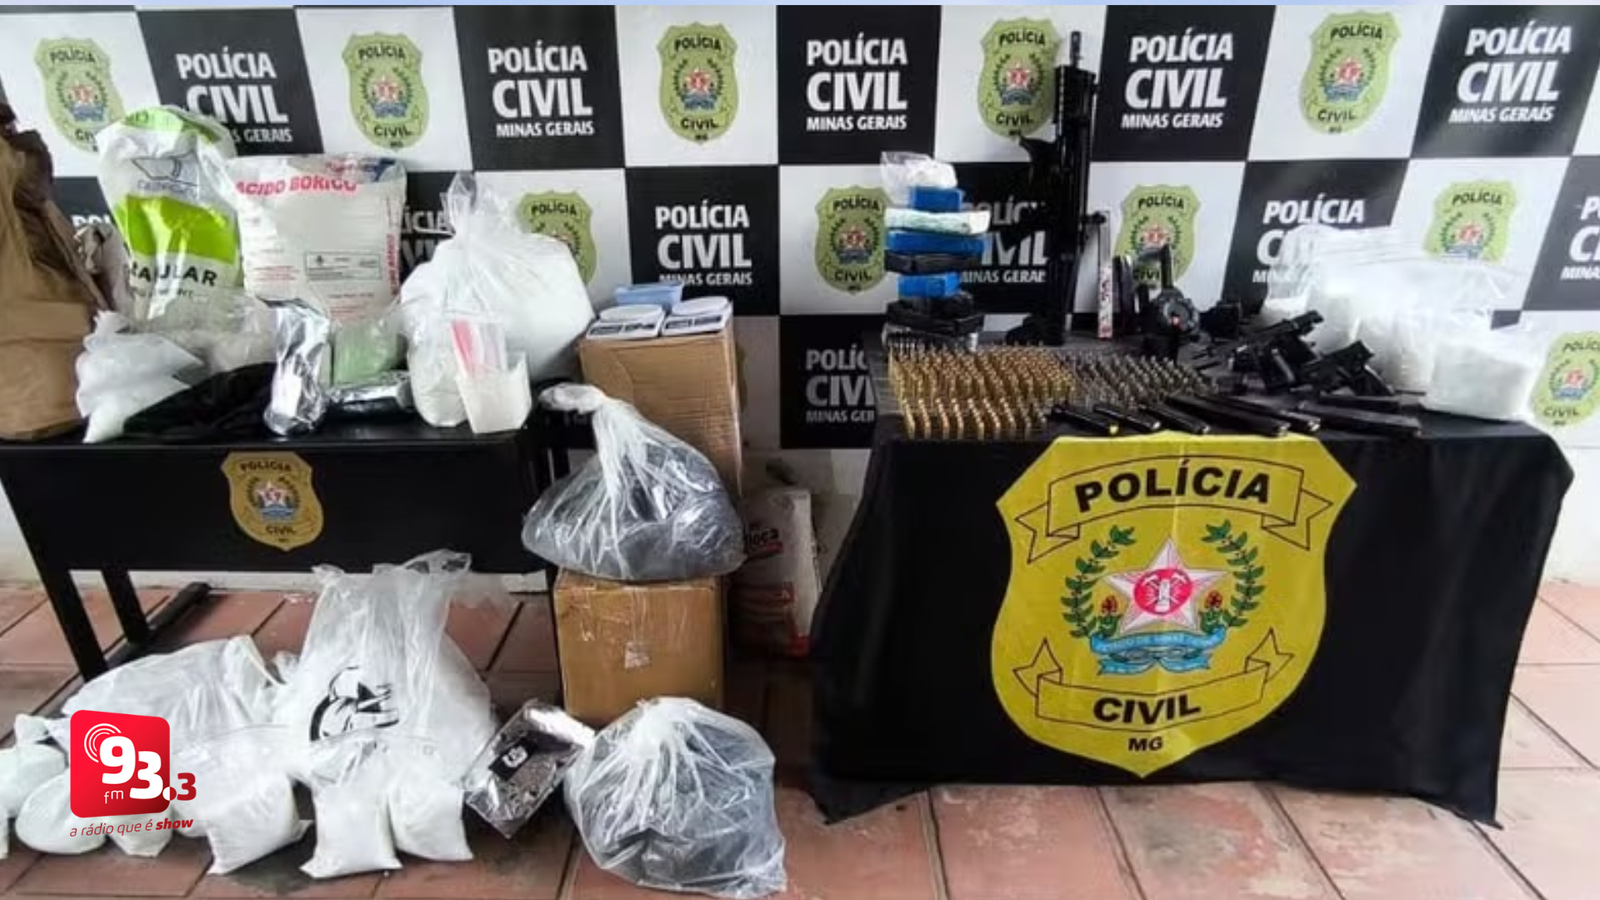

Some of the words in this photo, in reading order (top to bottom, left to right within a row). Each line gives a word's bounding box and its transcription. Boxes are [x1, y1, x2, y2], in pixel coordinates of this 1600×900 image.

[999, 29, 1045, 47] POLÍCIA
[1331, 21, 1382, 39] POLÍCIA
[1465, 19, 1571, 56] POLÍCIA
[358, 42, 406, 60] POLÍCIA
[674, 33, 721, 51] POLÍCIA
[807, 32, 907, 66] POLÍCIA
[1129, 27, 1233, 62] POLÍCIA
[176, 46, 277, 79] POLÍCIA
[488, 40, 588, 73] POLÍCIA
[807, 71, 908, 111] CIVIL
[1125, 68, 1227, 109] CIVIL
[1457, 60, 1560, 103] CIVIL
[187, 84, 289, 123] CIVIL
[492, 78, 593, 118] CIVIL
[681, 117, 719, 131] CIVIL
[806, 116, 854, 131] MINAS
[857, 115, 907, 130] GERAIS
[1121, 113, 1169, 130] MINAS
[1172, 112, 1223, 128] GERAIS
[1318, 108, 1356, 122] CIVIL
[1448, 106, 1497, 124] MINAS
[1498, 104, 1555, 122] GERAIS
[243, 127, 293, 142] GERAIS
[374, 124, 413, 138] CIVIL
[496, 122, 542, 137] MINAS
[545, 120, 594, 136] GERAIS
[832, 194, 880, 212] POLÍCIA
[1138, 191, 1184, 210] POLÍCIA
[1451, 189, 1502, 206] POLÍCIA
[531, 200, 577, 216] POLÍCIA
[655, 198, 750, 230] POLÍCIA
[1262, 192, 1365, 225] POLÍCIA
[658, 232, 752, 270] CIVIL
[705, 271, 753, 286] GERAIS
[806, 343, 869, 371] POLÍC
[806, 375, 876, 407] CIVI
[1075, 459, 1270, 513] POLÍCIA
[1093, 694, 1202, 725] CIVIL
[1128, 736, 1163, 752] MG
